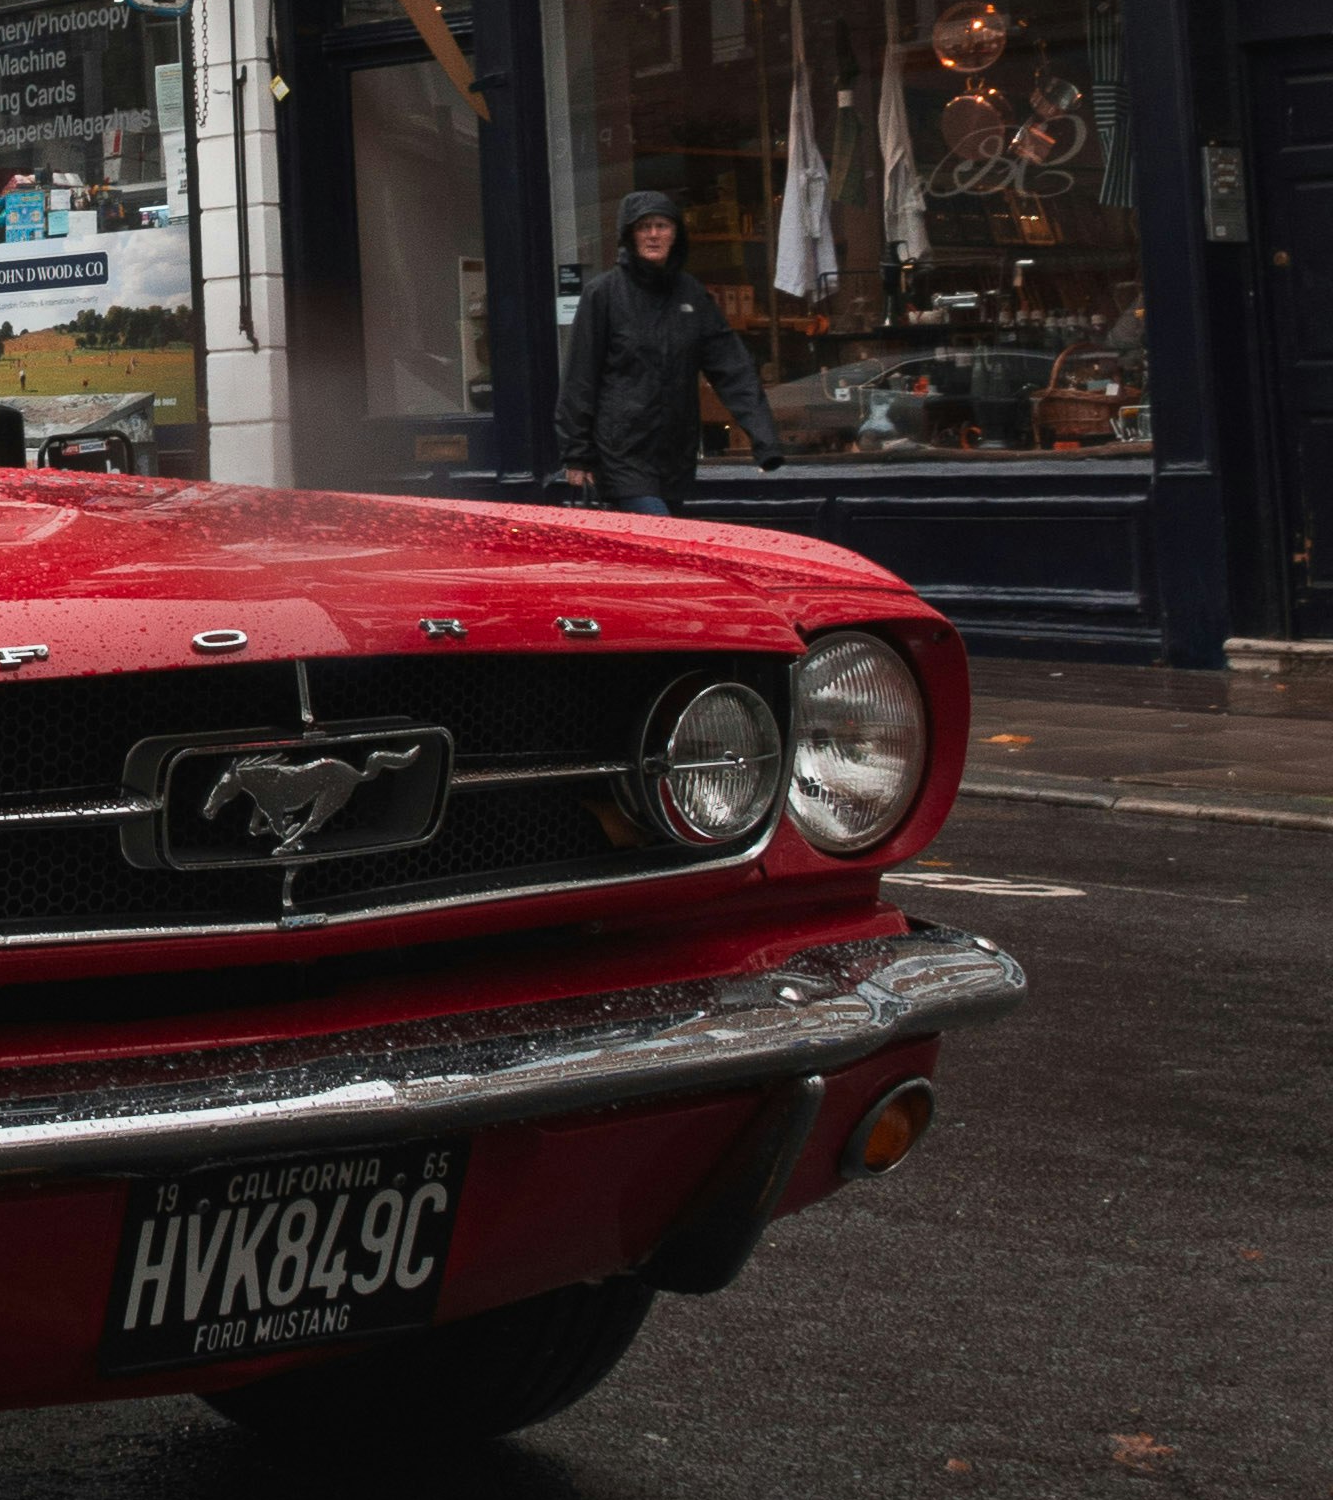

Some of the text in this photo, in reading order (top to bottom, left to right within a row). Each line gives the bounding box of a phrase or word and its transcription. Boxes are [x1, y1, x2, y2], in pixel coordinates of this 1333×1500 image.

[24, 79, 77, 108] Cards
[26, 268, 36, 282] D
[37, 264, 73, 281] WOOD
[74, 264, 84, 278] &
[156, 1151, 451, 1214] 19 CALIFORNIA 65
[122, 1182, 448, 1331] HVK849C
[193, 1303, 351, 1353] FORD MUSTANG
